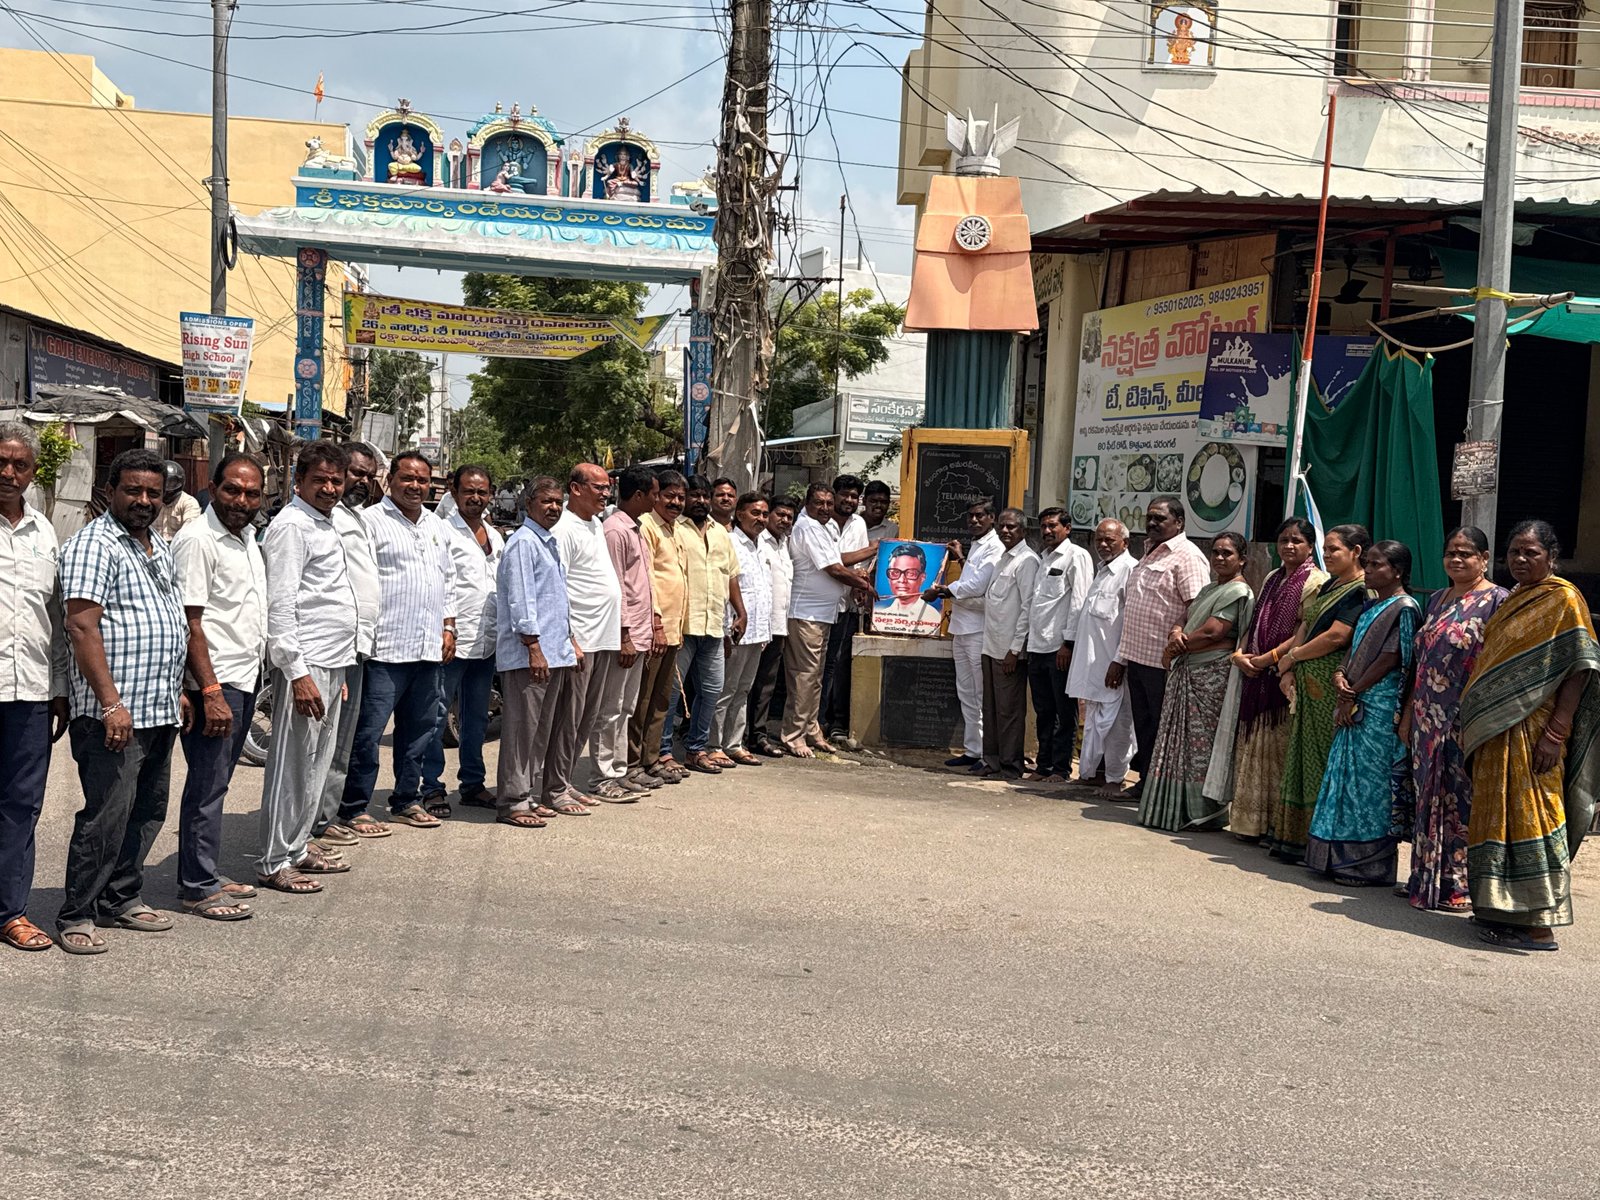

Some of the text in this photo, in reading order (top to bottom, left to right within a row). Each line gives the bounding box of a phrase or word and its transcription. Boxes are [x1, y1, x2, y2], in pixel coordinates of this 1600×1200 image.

[1153, 281, 1264, 315] 9550162025, 9849243951
[184, 316, 227, 326] ADMISSIONS
[229, 320, 248, 328] OPEN
[182, 332, 248, 350] Rising Sun
[46, 335, 75, 360] GAJE
[75, 343, 111, 372] EVENTS
[183, 350, 235, 363] High School
[1101, 327, 1160, 376] నక్షత్ర
[1217, 357, 1251, 365] MULKANUR
[208, 370, 226, 378] Results
[228, 371, 243, 380] 100%
